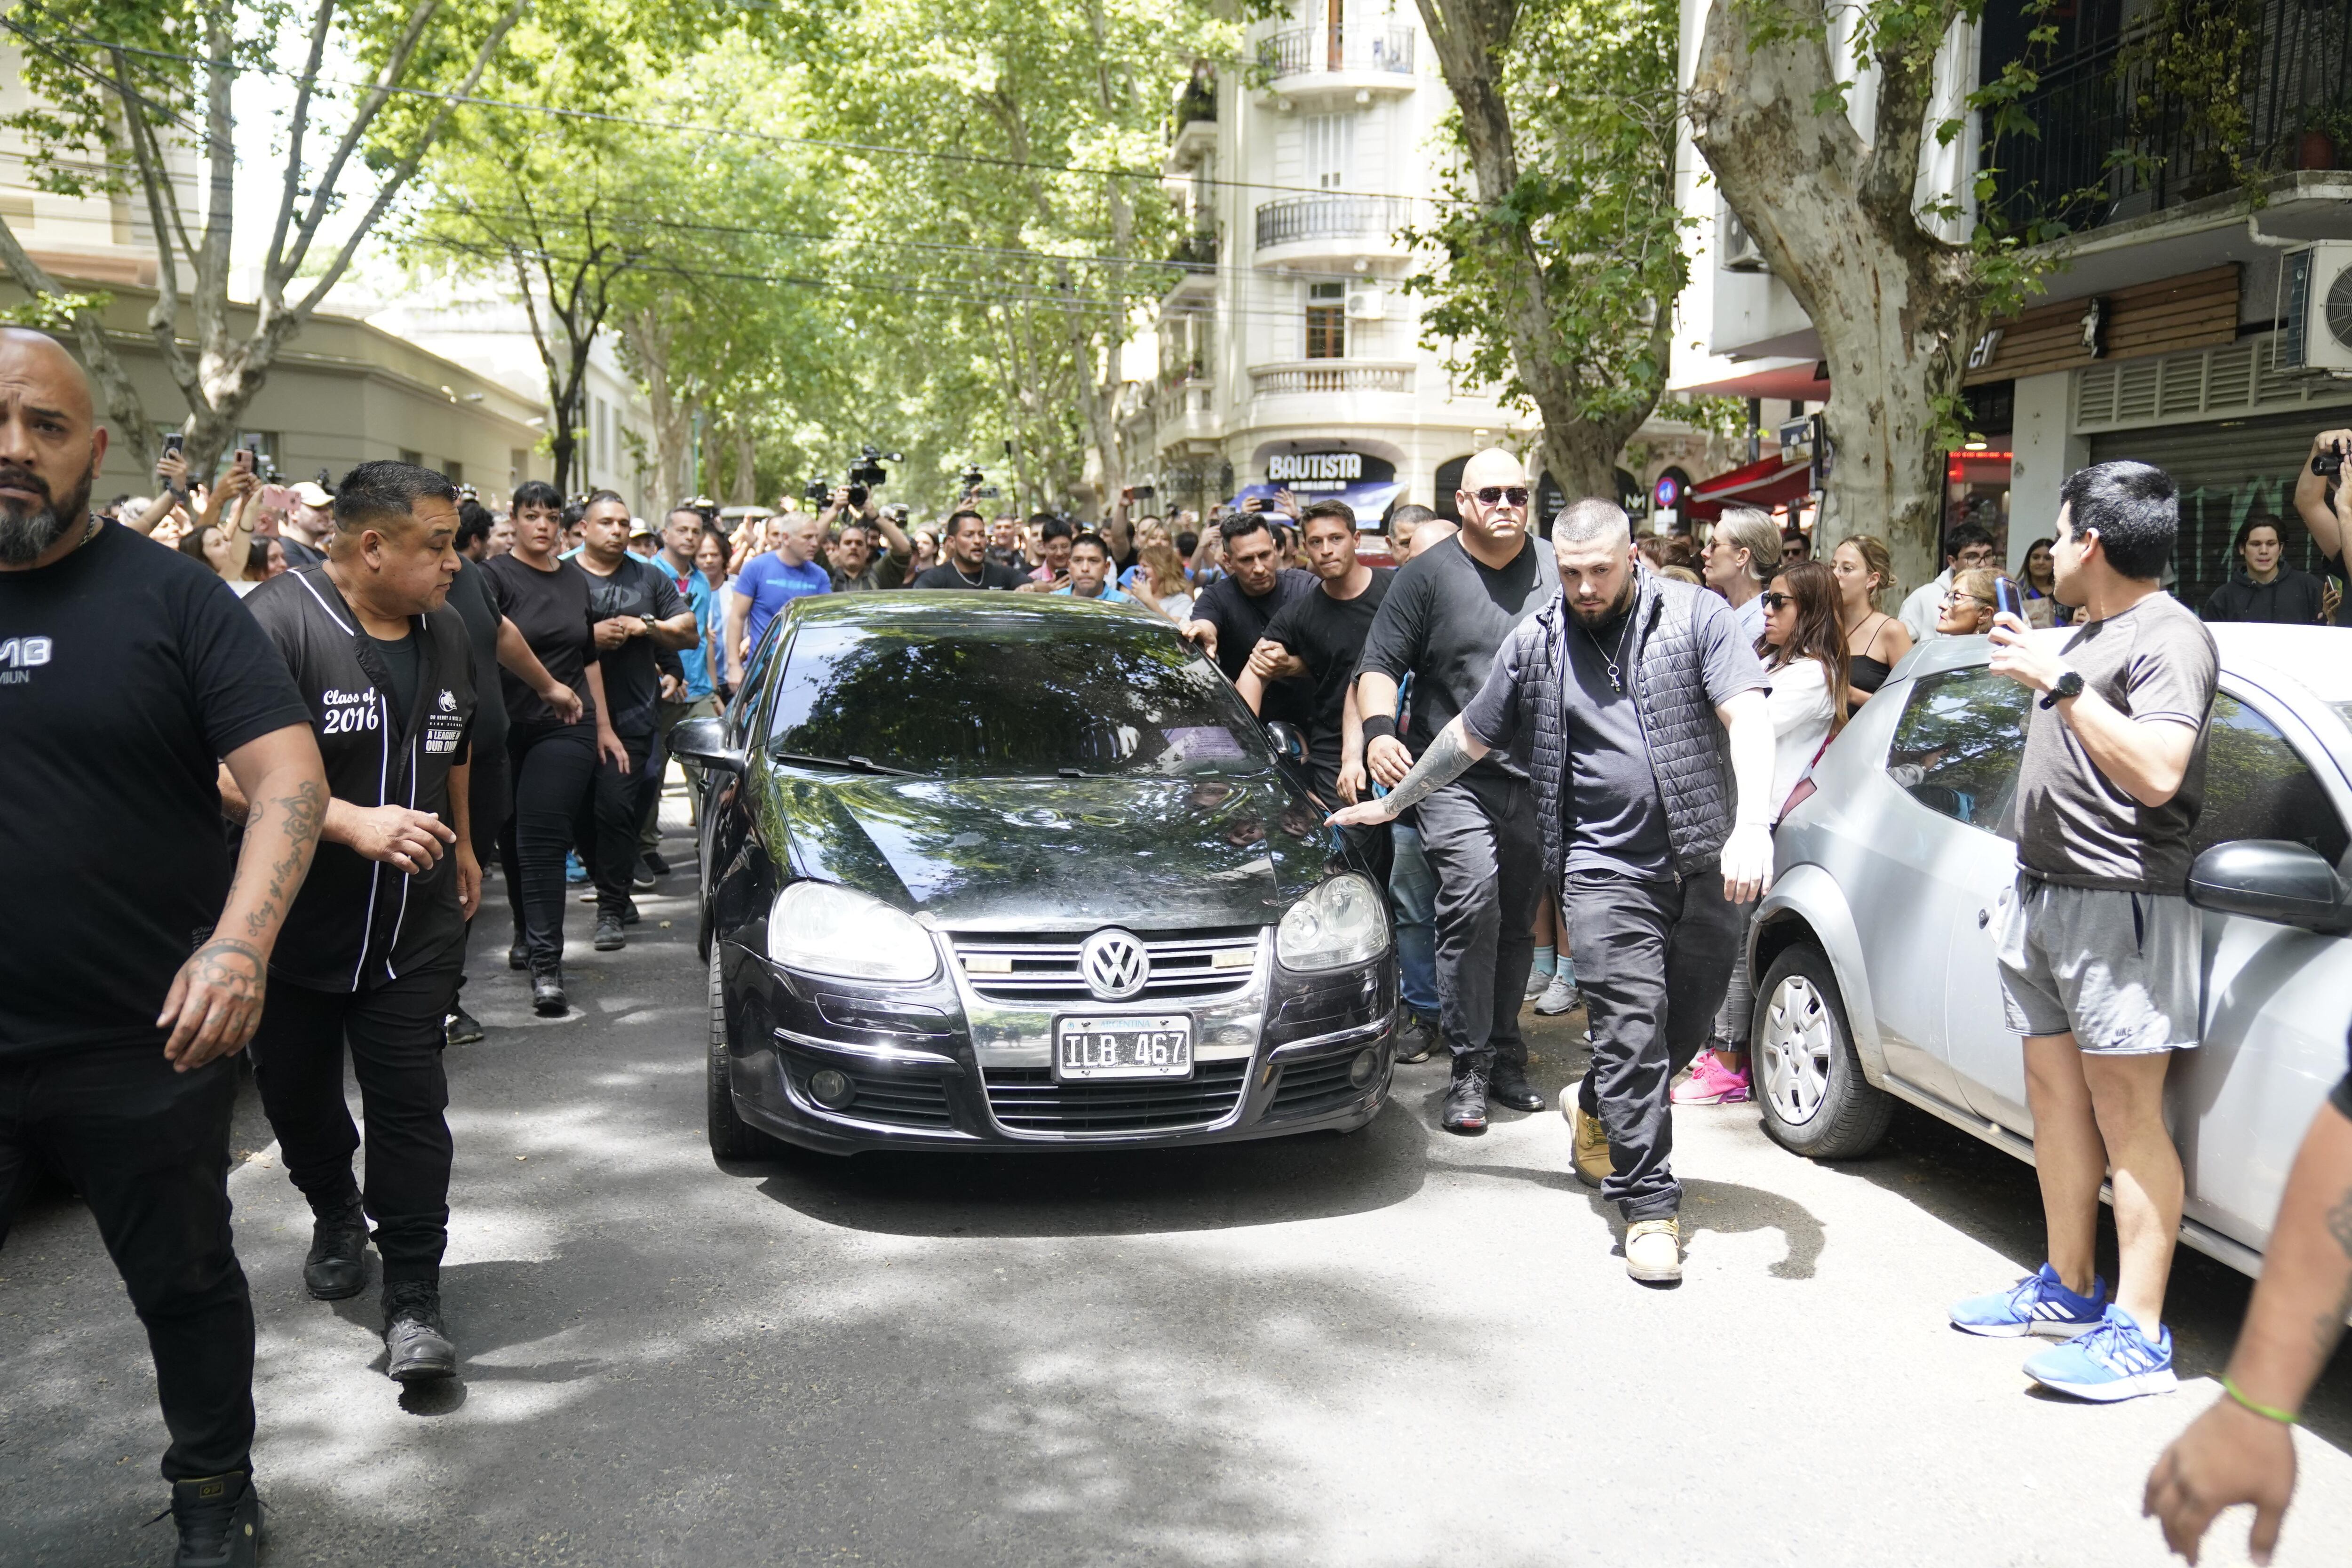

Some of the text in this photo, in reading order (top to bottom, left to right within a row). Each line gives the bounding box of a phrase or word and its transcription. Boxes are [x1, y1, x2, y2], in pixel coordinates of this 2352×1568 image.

[1269, 453, 1362, 480] BAUTISTA
[323, 686, 376, 706] Class of
[323, 706, 379, 734] 2016
[427, 731, 433, 740] A
[433, 731, 456, 740] LEAGUE
[426, 740, 458, 752] OUR OWN
[1100, 1019, 1151, 1028] ARGENTINA
[2115, 1026, 2133, 1036] NIKE
[1065, 1033, 1184, 1067] ILB 467
